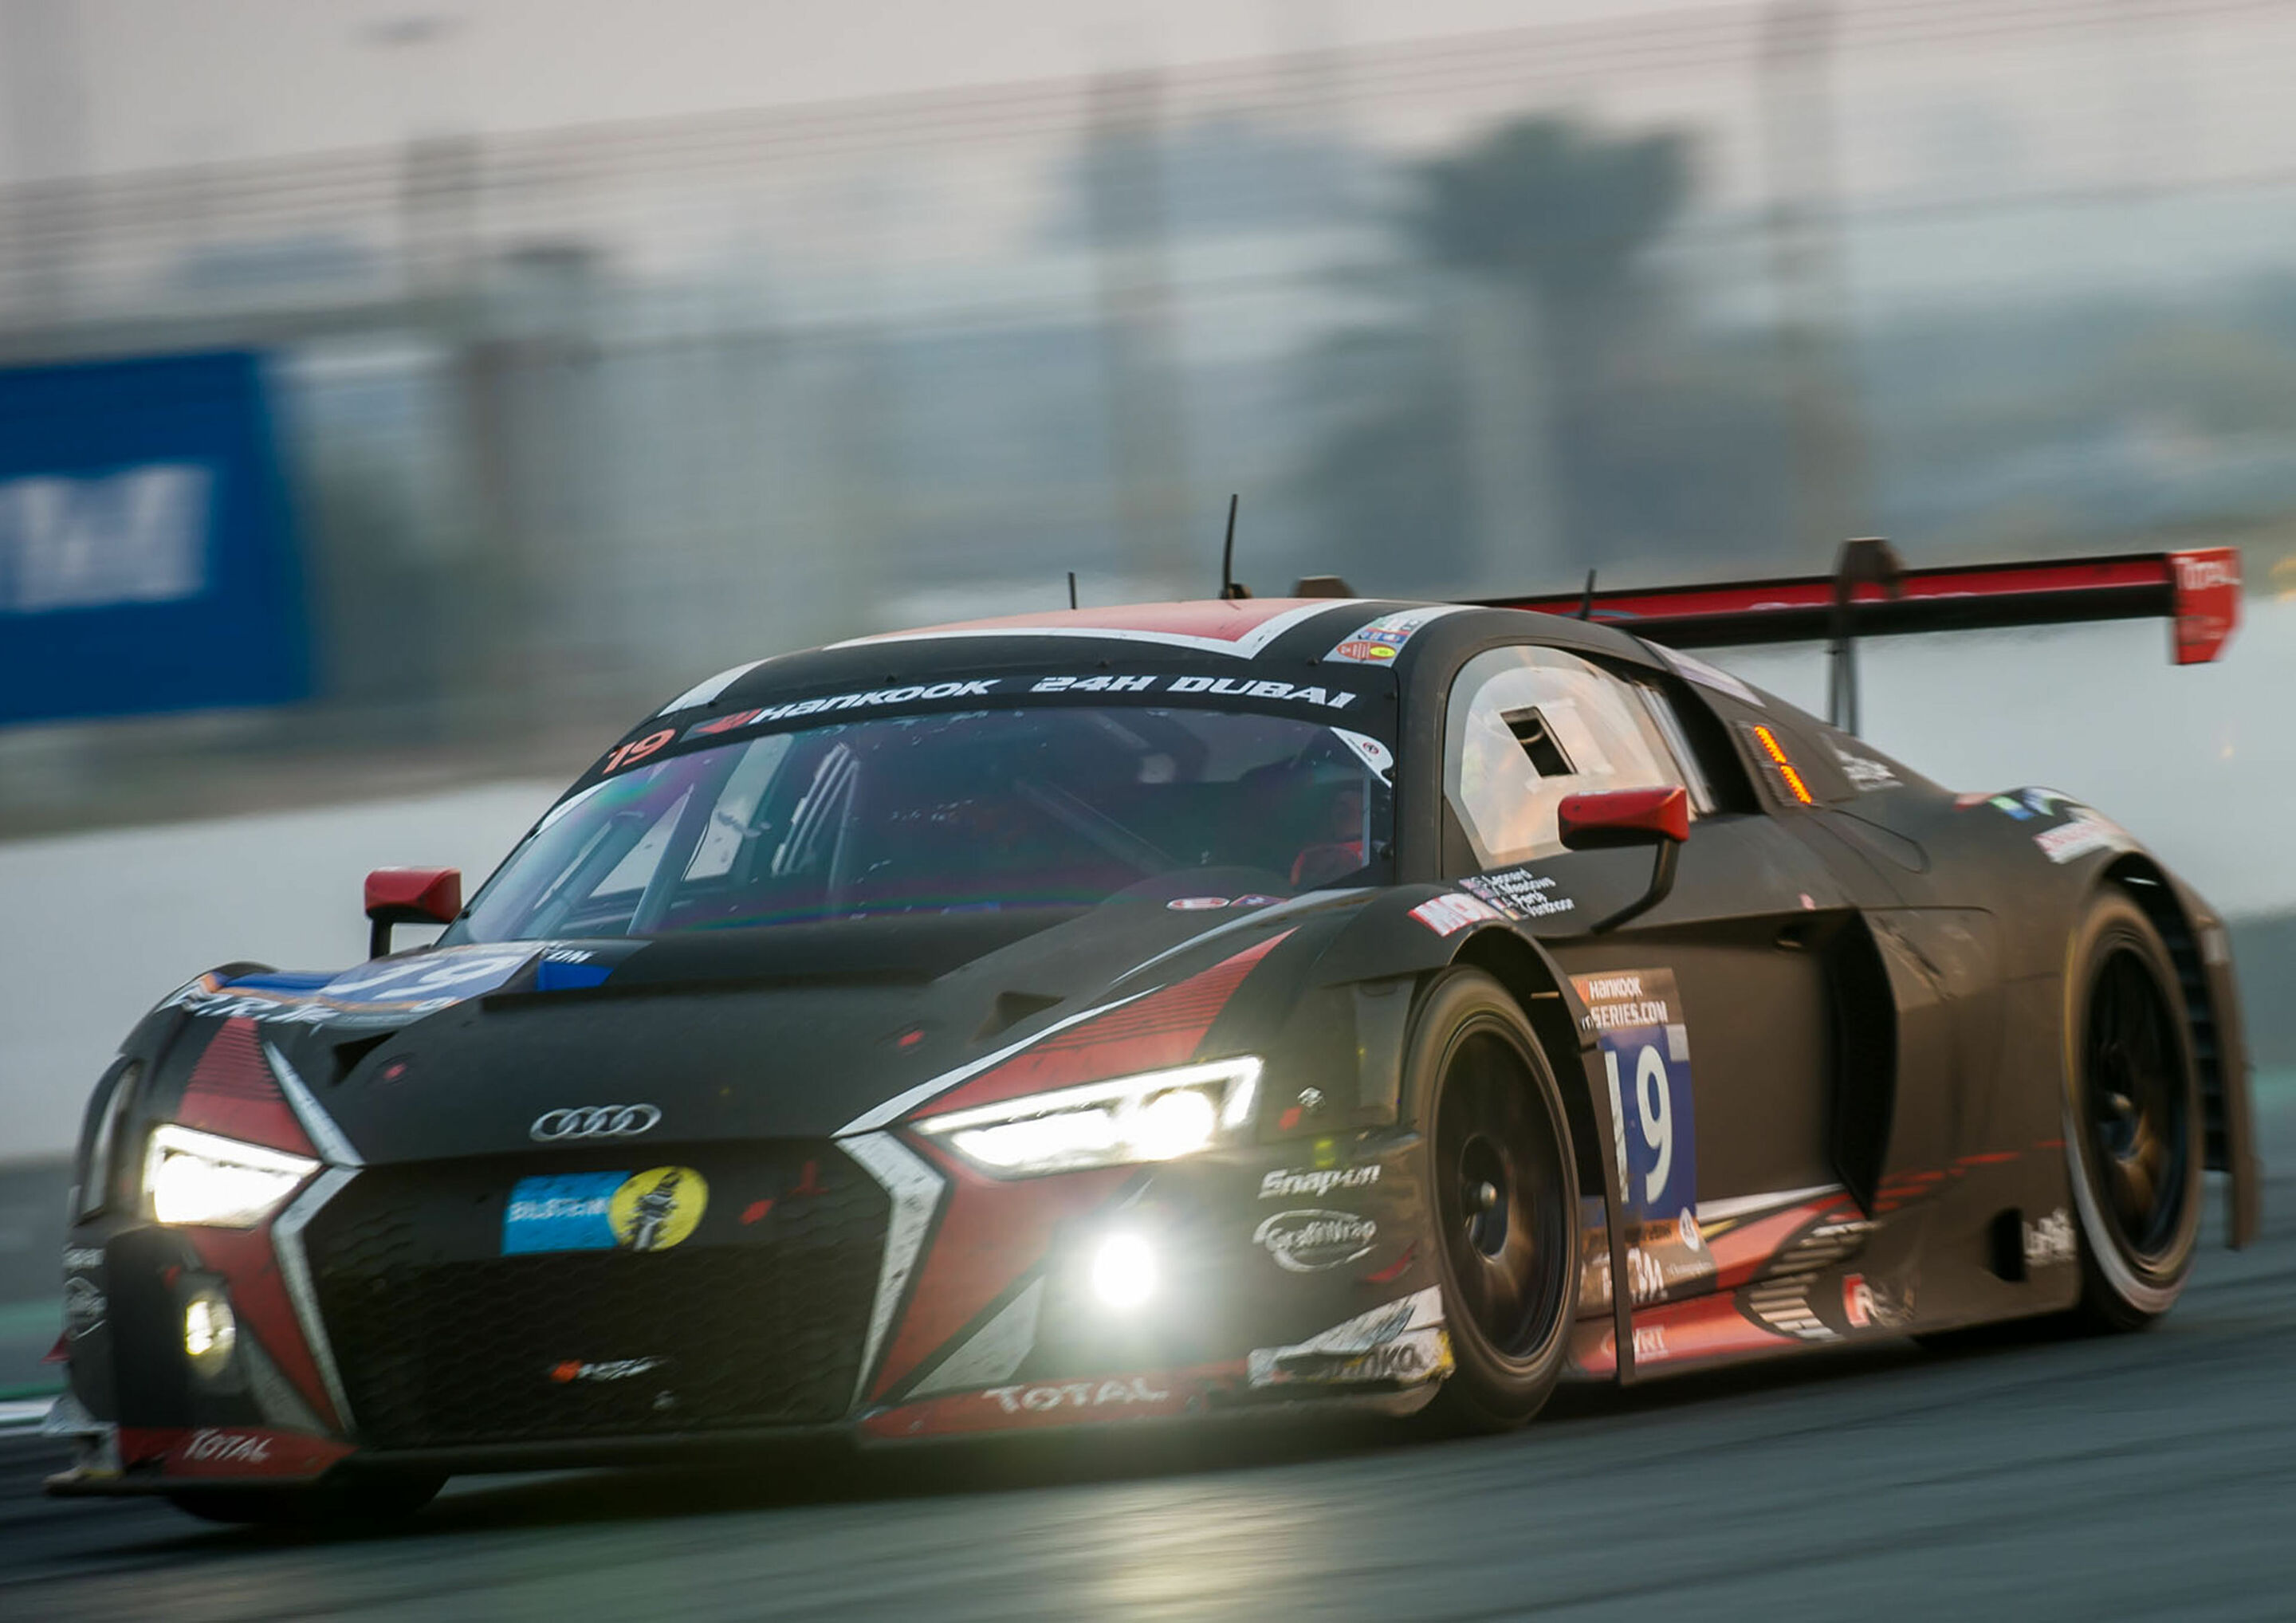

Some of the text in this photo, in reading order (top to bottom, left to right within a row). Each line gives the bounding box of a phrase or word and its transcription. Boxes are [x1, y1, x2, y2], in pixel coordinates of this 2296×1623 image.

[1031, 675, 1157, 693] 24H
[1166, 676, 1357, 709] DUBAI
[602, 728, 676, 775] 19
[319, 955, 523, 1001] 19
[1604, 1045, 1673, 1205] 19
[981, 1377, 1169, 1414] TOTAL
[183, 1428, 273, 1463] TOTAL
